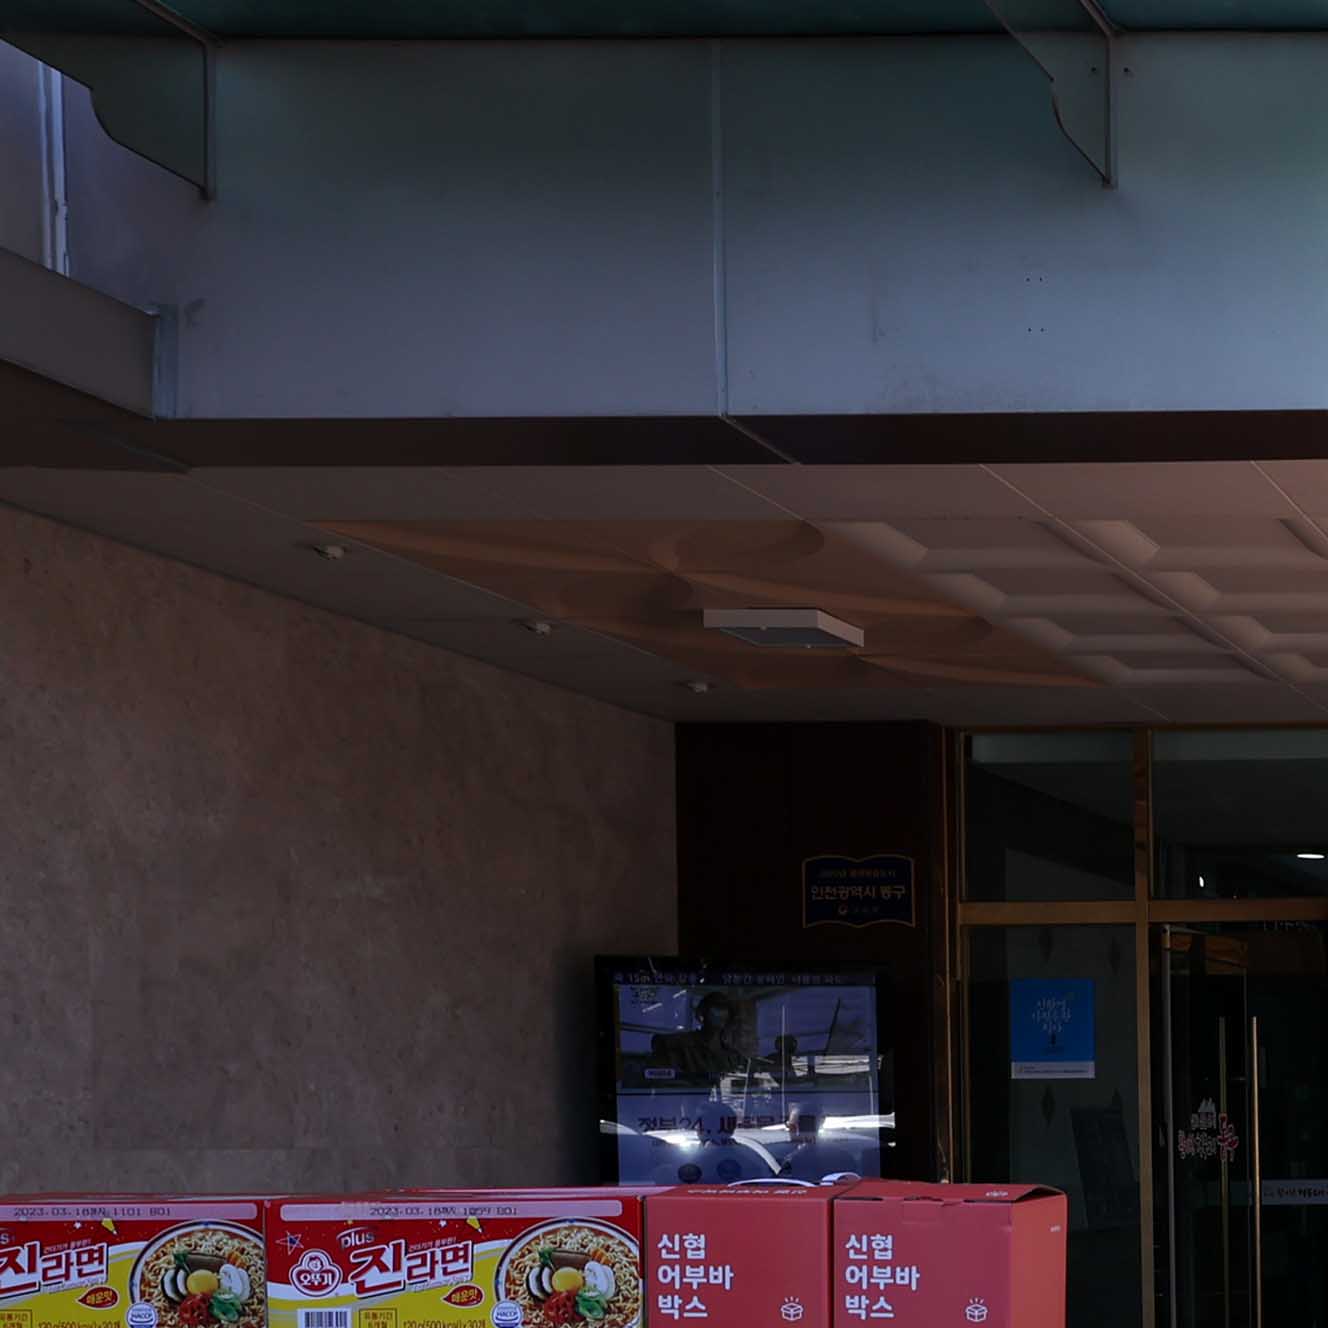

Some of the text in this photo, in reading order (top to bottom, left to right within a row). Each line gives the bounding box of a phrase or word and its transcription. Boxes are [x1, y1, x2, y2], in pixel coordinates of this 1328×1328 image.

[340, 1231, 375, 1249] plus
[657, 1234, 706, 1260] 신협
[845, 1233, 893, 1259] 신협
[299, 1271, 333, 1287] 오뚜기
[349, 1239, 473, 1299] 진라면
[657, 1265, 734, 1290] 어부바
[845, 1265, 920, 1291] 어부바
[657, 1294, 708, 1319] 박스
[845, 1294, 894, 1320] 박스
